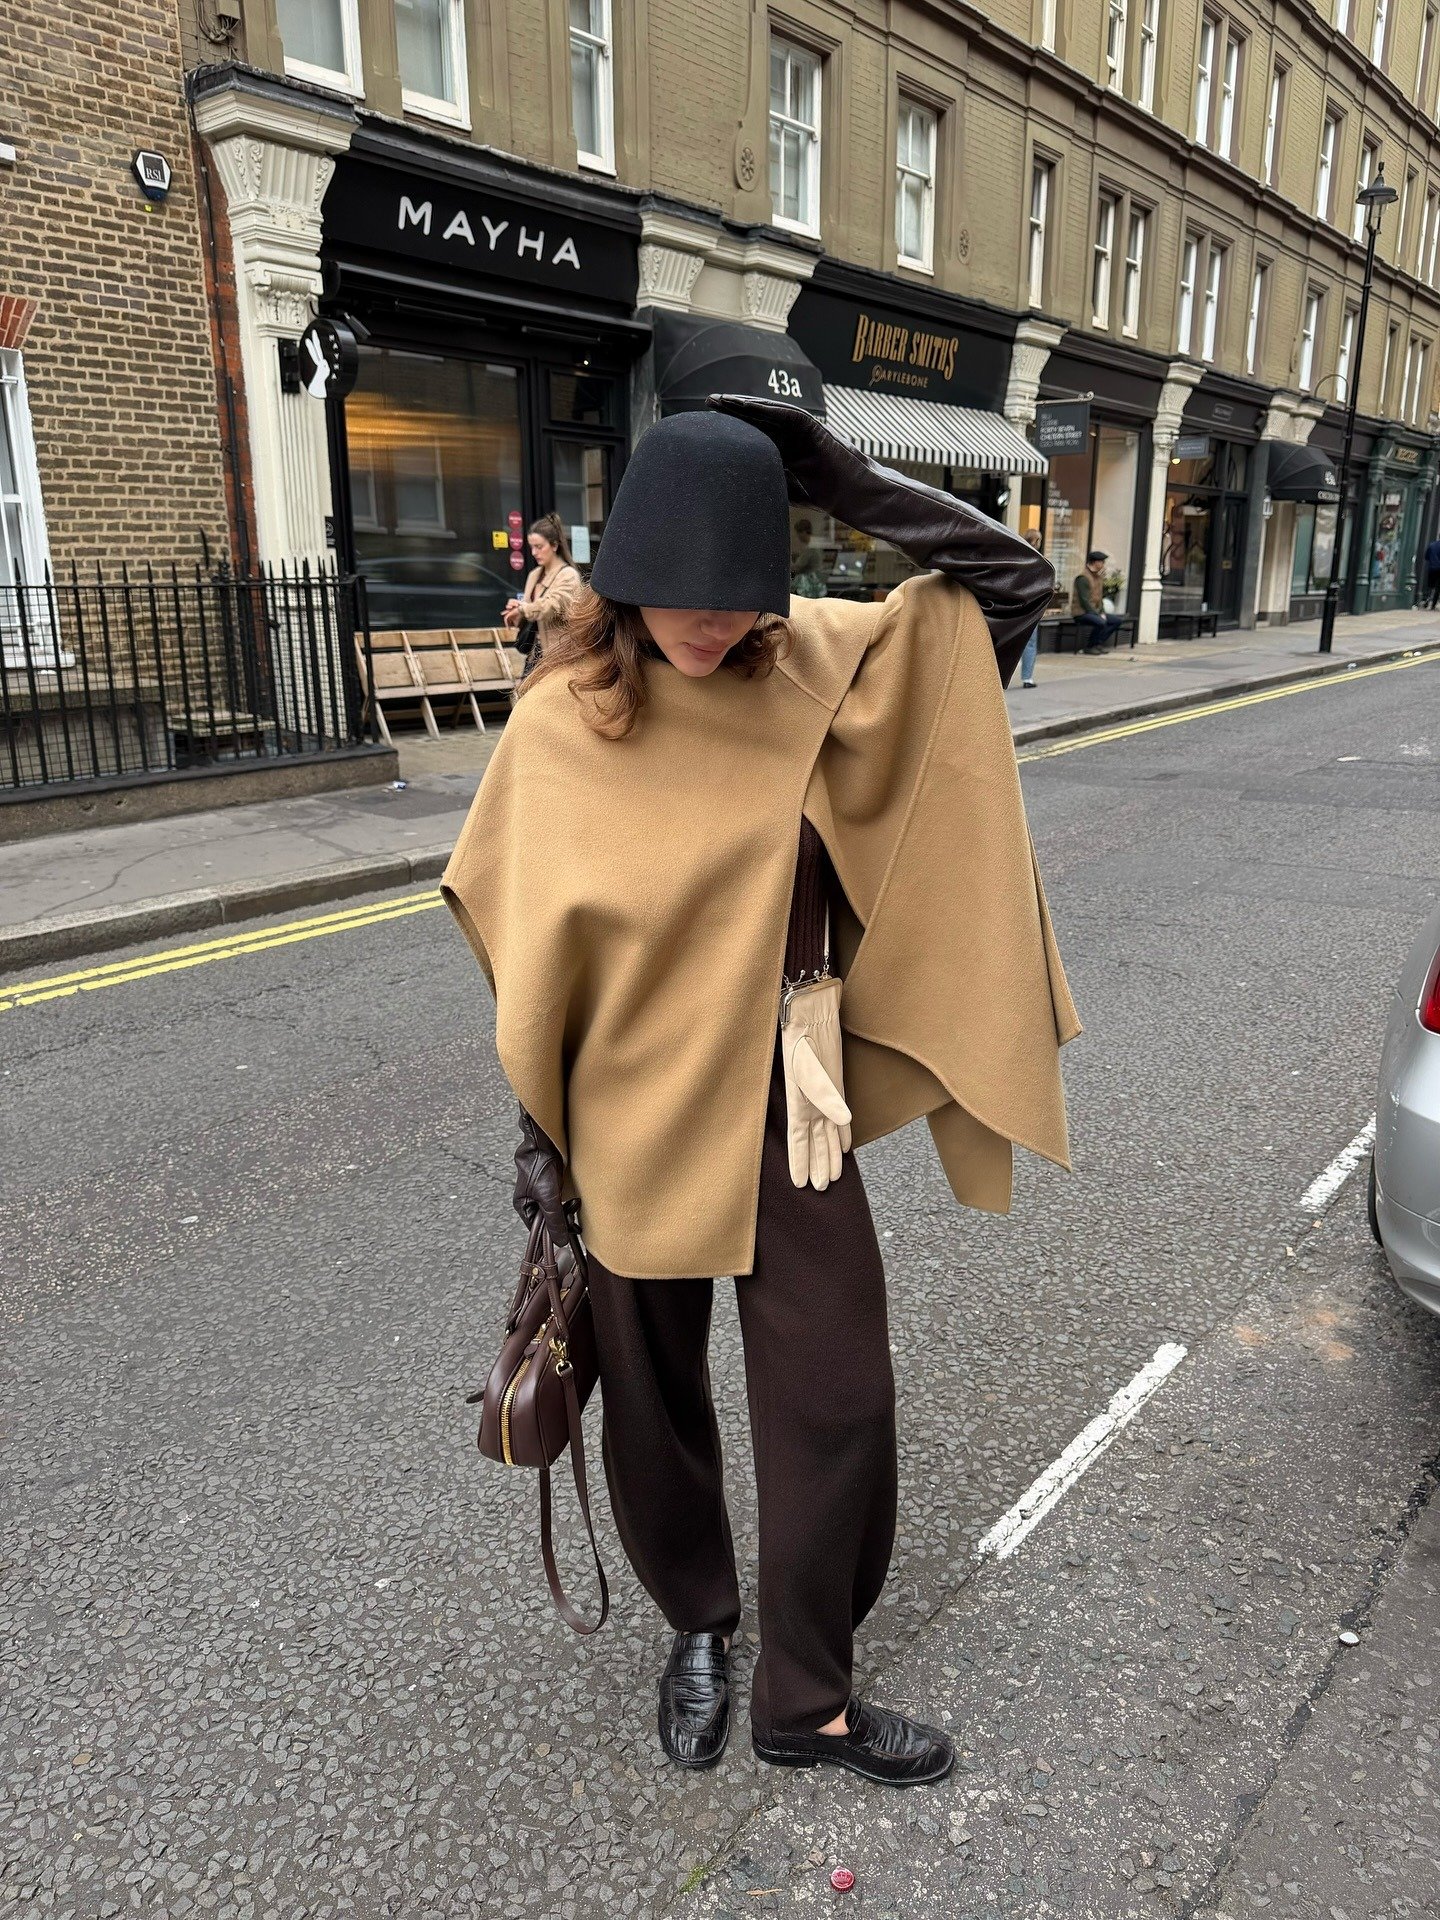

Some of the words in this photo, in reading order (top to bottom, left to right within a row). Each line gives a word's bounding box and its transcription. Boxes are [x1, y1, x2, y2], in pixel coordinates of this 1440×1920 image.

[398, 196, 581, 270] MAYHA
[328, 334, 340, 380] MAYHA
[852, 314, 908, 362] BARBER
[909, 331, 959, 380] SMITHS
[767, 368, 803, 398] 43a
